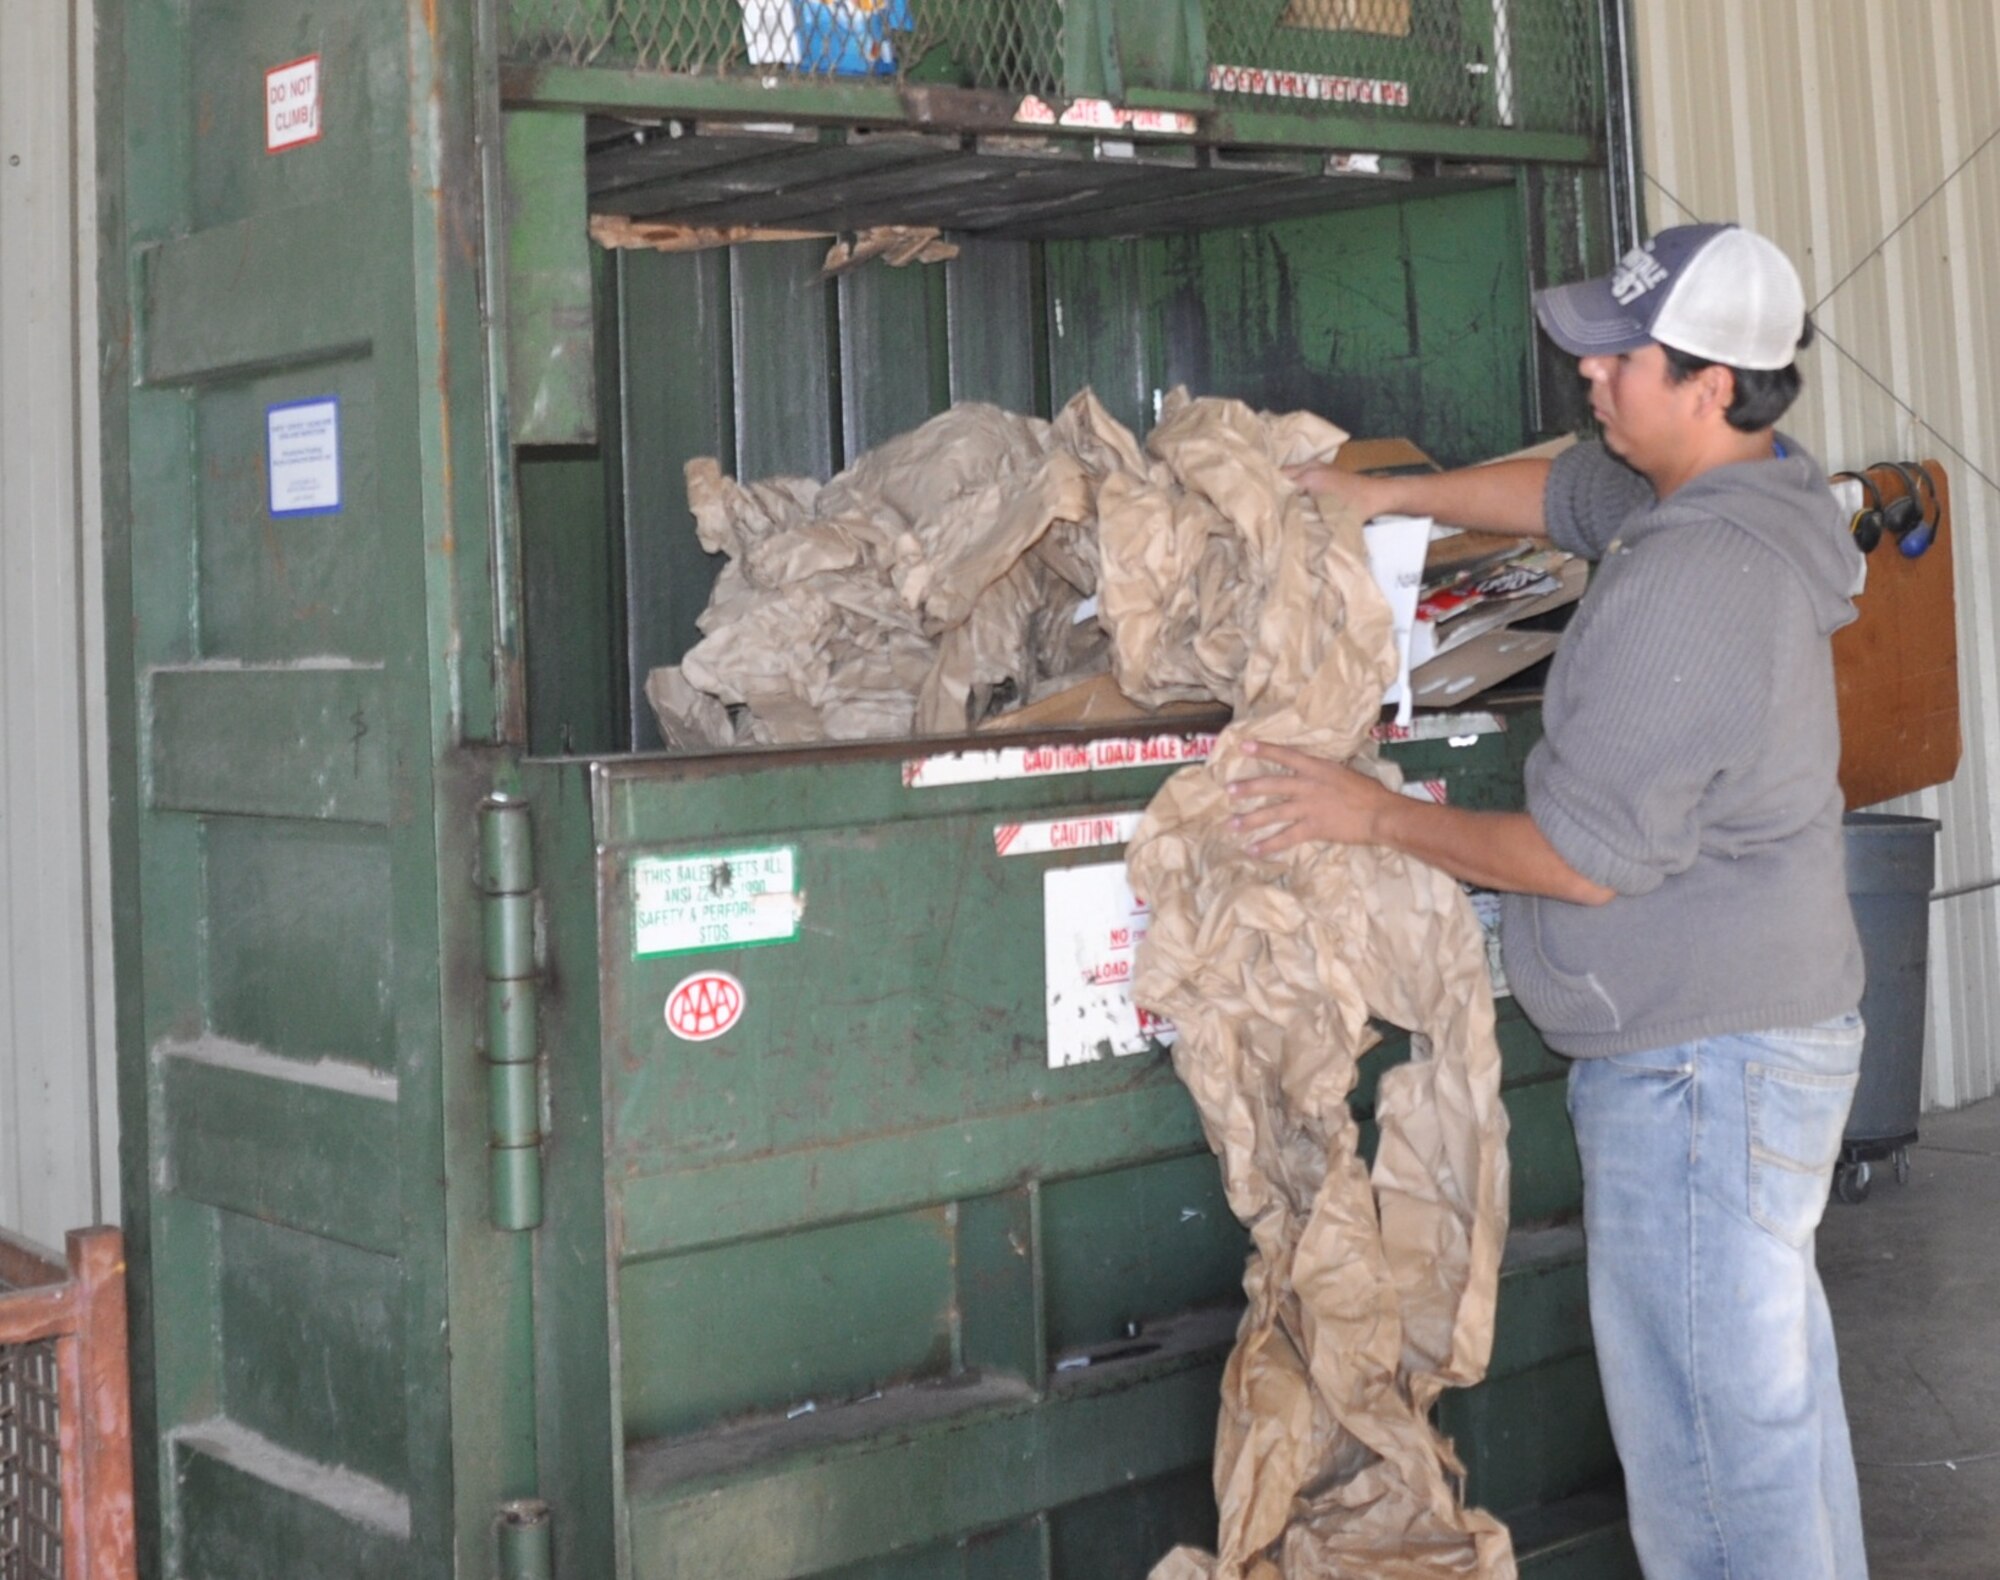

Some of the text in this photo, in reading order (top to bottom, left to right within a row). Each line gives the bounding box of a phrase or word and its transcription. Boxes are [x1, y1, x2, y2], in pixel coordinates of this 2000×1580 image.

[270, 75, 312, 104] DO NOT
[275, 106, 309, 131] CLIMB
[1097, 745, 1135, 767] LOAD
[1140, 743, 1176, 762] BALE
[644, 869, 672, 885] THIS
[764, 856, 784, 875] ALL
[665, 887, 692, 902] ANSI
[638, 909, 685, 928] SAFETY
[690, 907, 697, 922] &
[1110, 928, 1129, 945] NO
[1095, 961, 1129, 980] LOAD
[670, 977, 739, 1036] AAA
